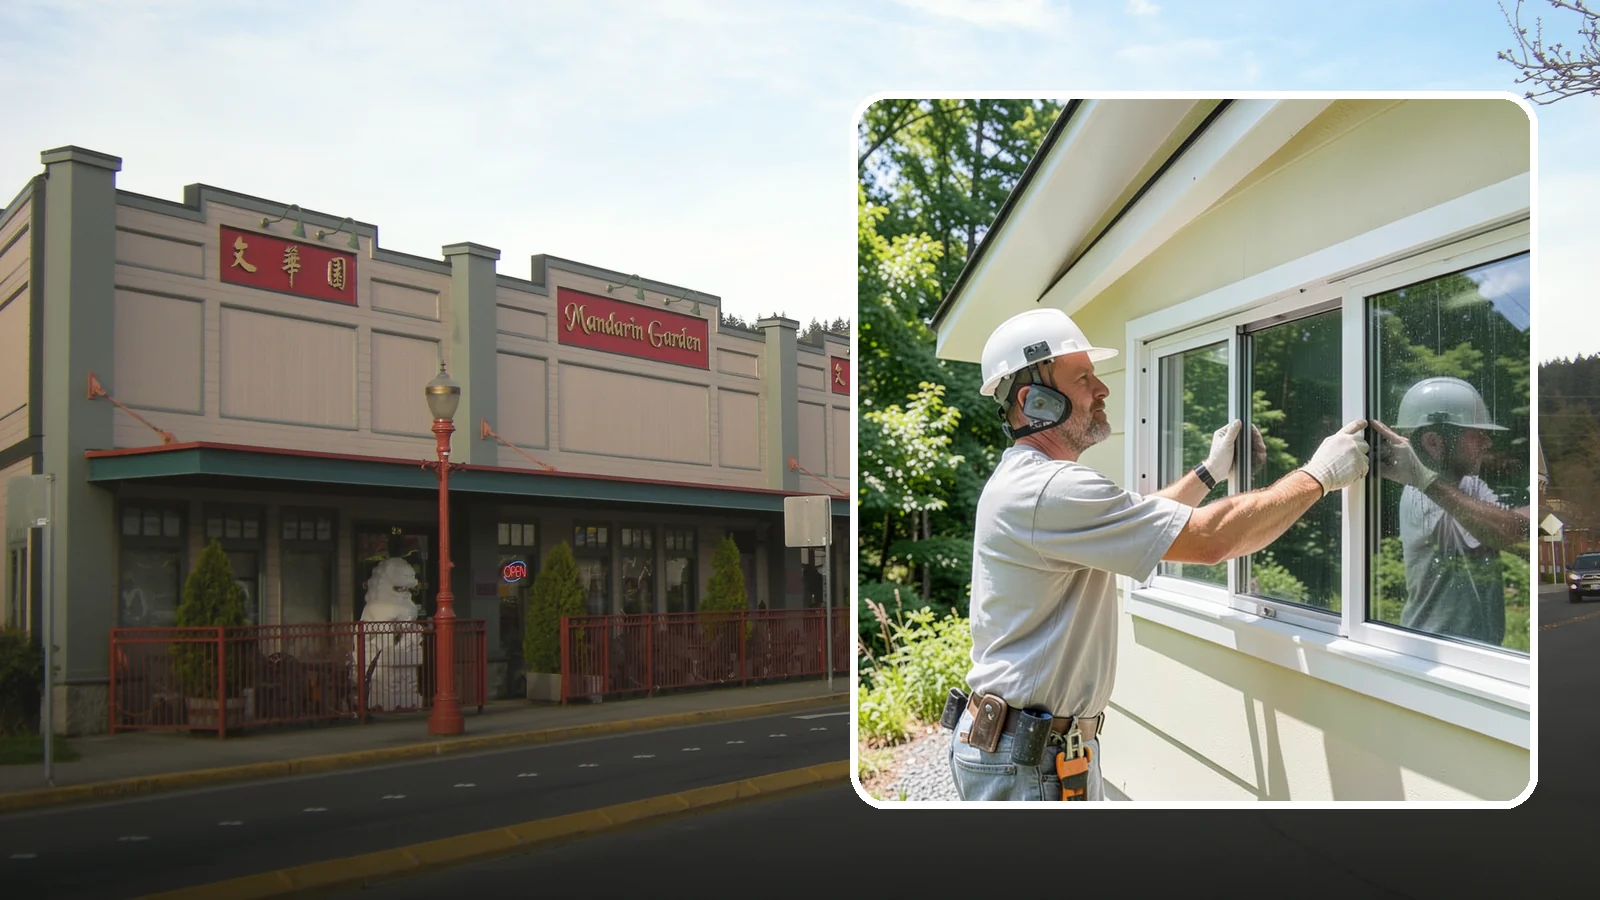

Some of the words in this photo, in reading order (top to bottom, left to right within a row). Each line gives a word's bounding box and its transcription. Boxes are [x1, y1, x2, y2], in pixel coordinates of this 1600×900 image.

[231, 235, 346, 291] 文華園
[564, 302, 644, 341] Mandarin
[648, 320, 701, 352] Garden
[503, 565, 527, 578] OPEN
